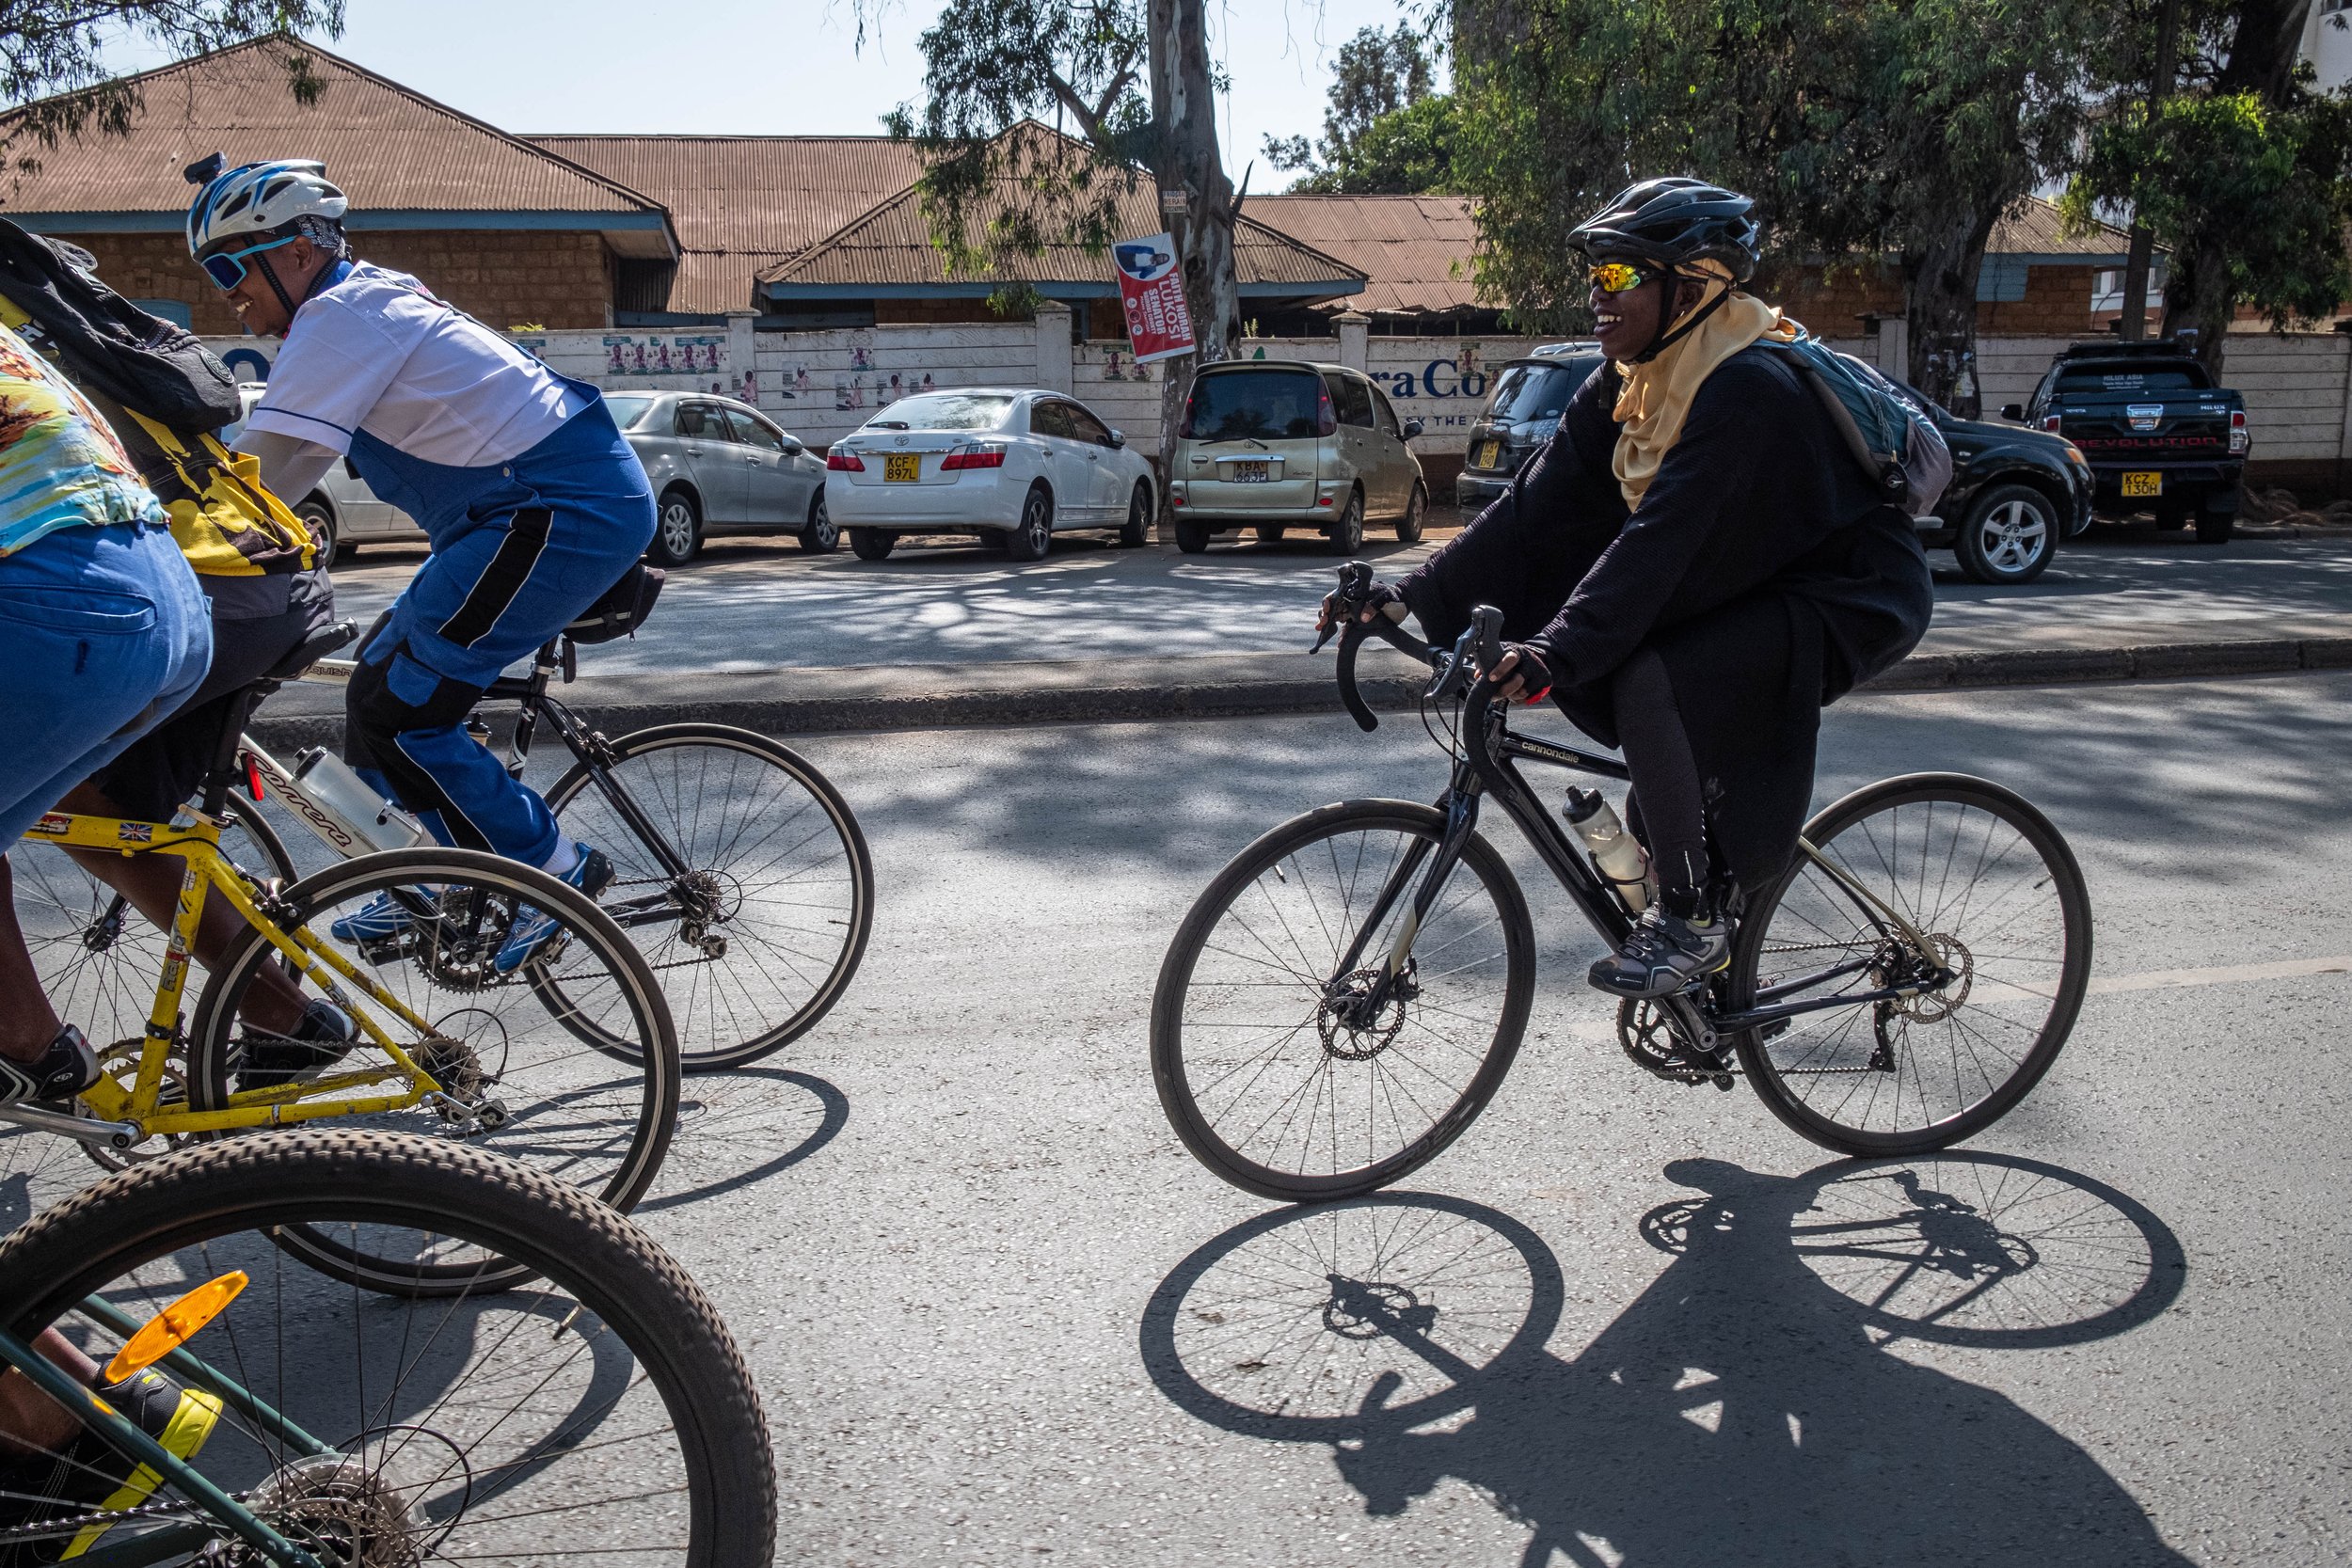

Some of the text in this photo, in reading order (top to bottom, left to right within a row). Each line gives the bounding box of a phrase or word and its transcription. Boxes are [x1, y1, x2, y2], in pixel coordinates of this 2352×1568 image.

[1149, 288, 1167, 335] SENATOR
[1159, 280, 1181, 340] LUKOSI
[1169, 273, 1191, 341] FAITH NORAH
[1147, 313, 1156, 334] COUNTY
[1435, 416, 1467, 426] THE
[2073, 436, 2218, 448] REVOLUTION
[887, 456, 909, 467] KCF
[1236, 462, 1261, 471] KBA
[887, 469, 916, 480] 897L
[2125, 474, 2150, 485] KCZ
[2126, 484, 2158, 495] 130H
[310, 666, 353, 676] quish
[1521, 740, 1580, 764] cannondale
